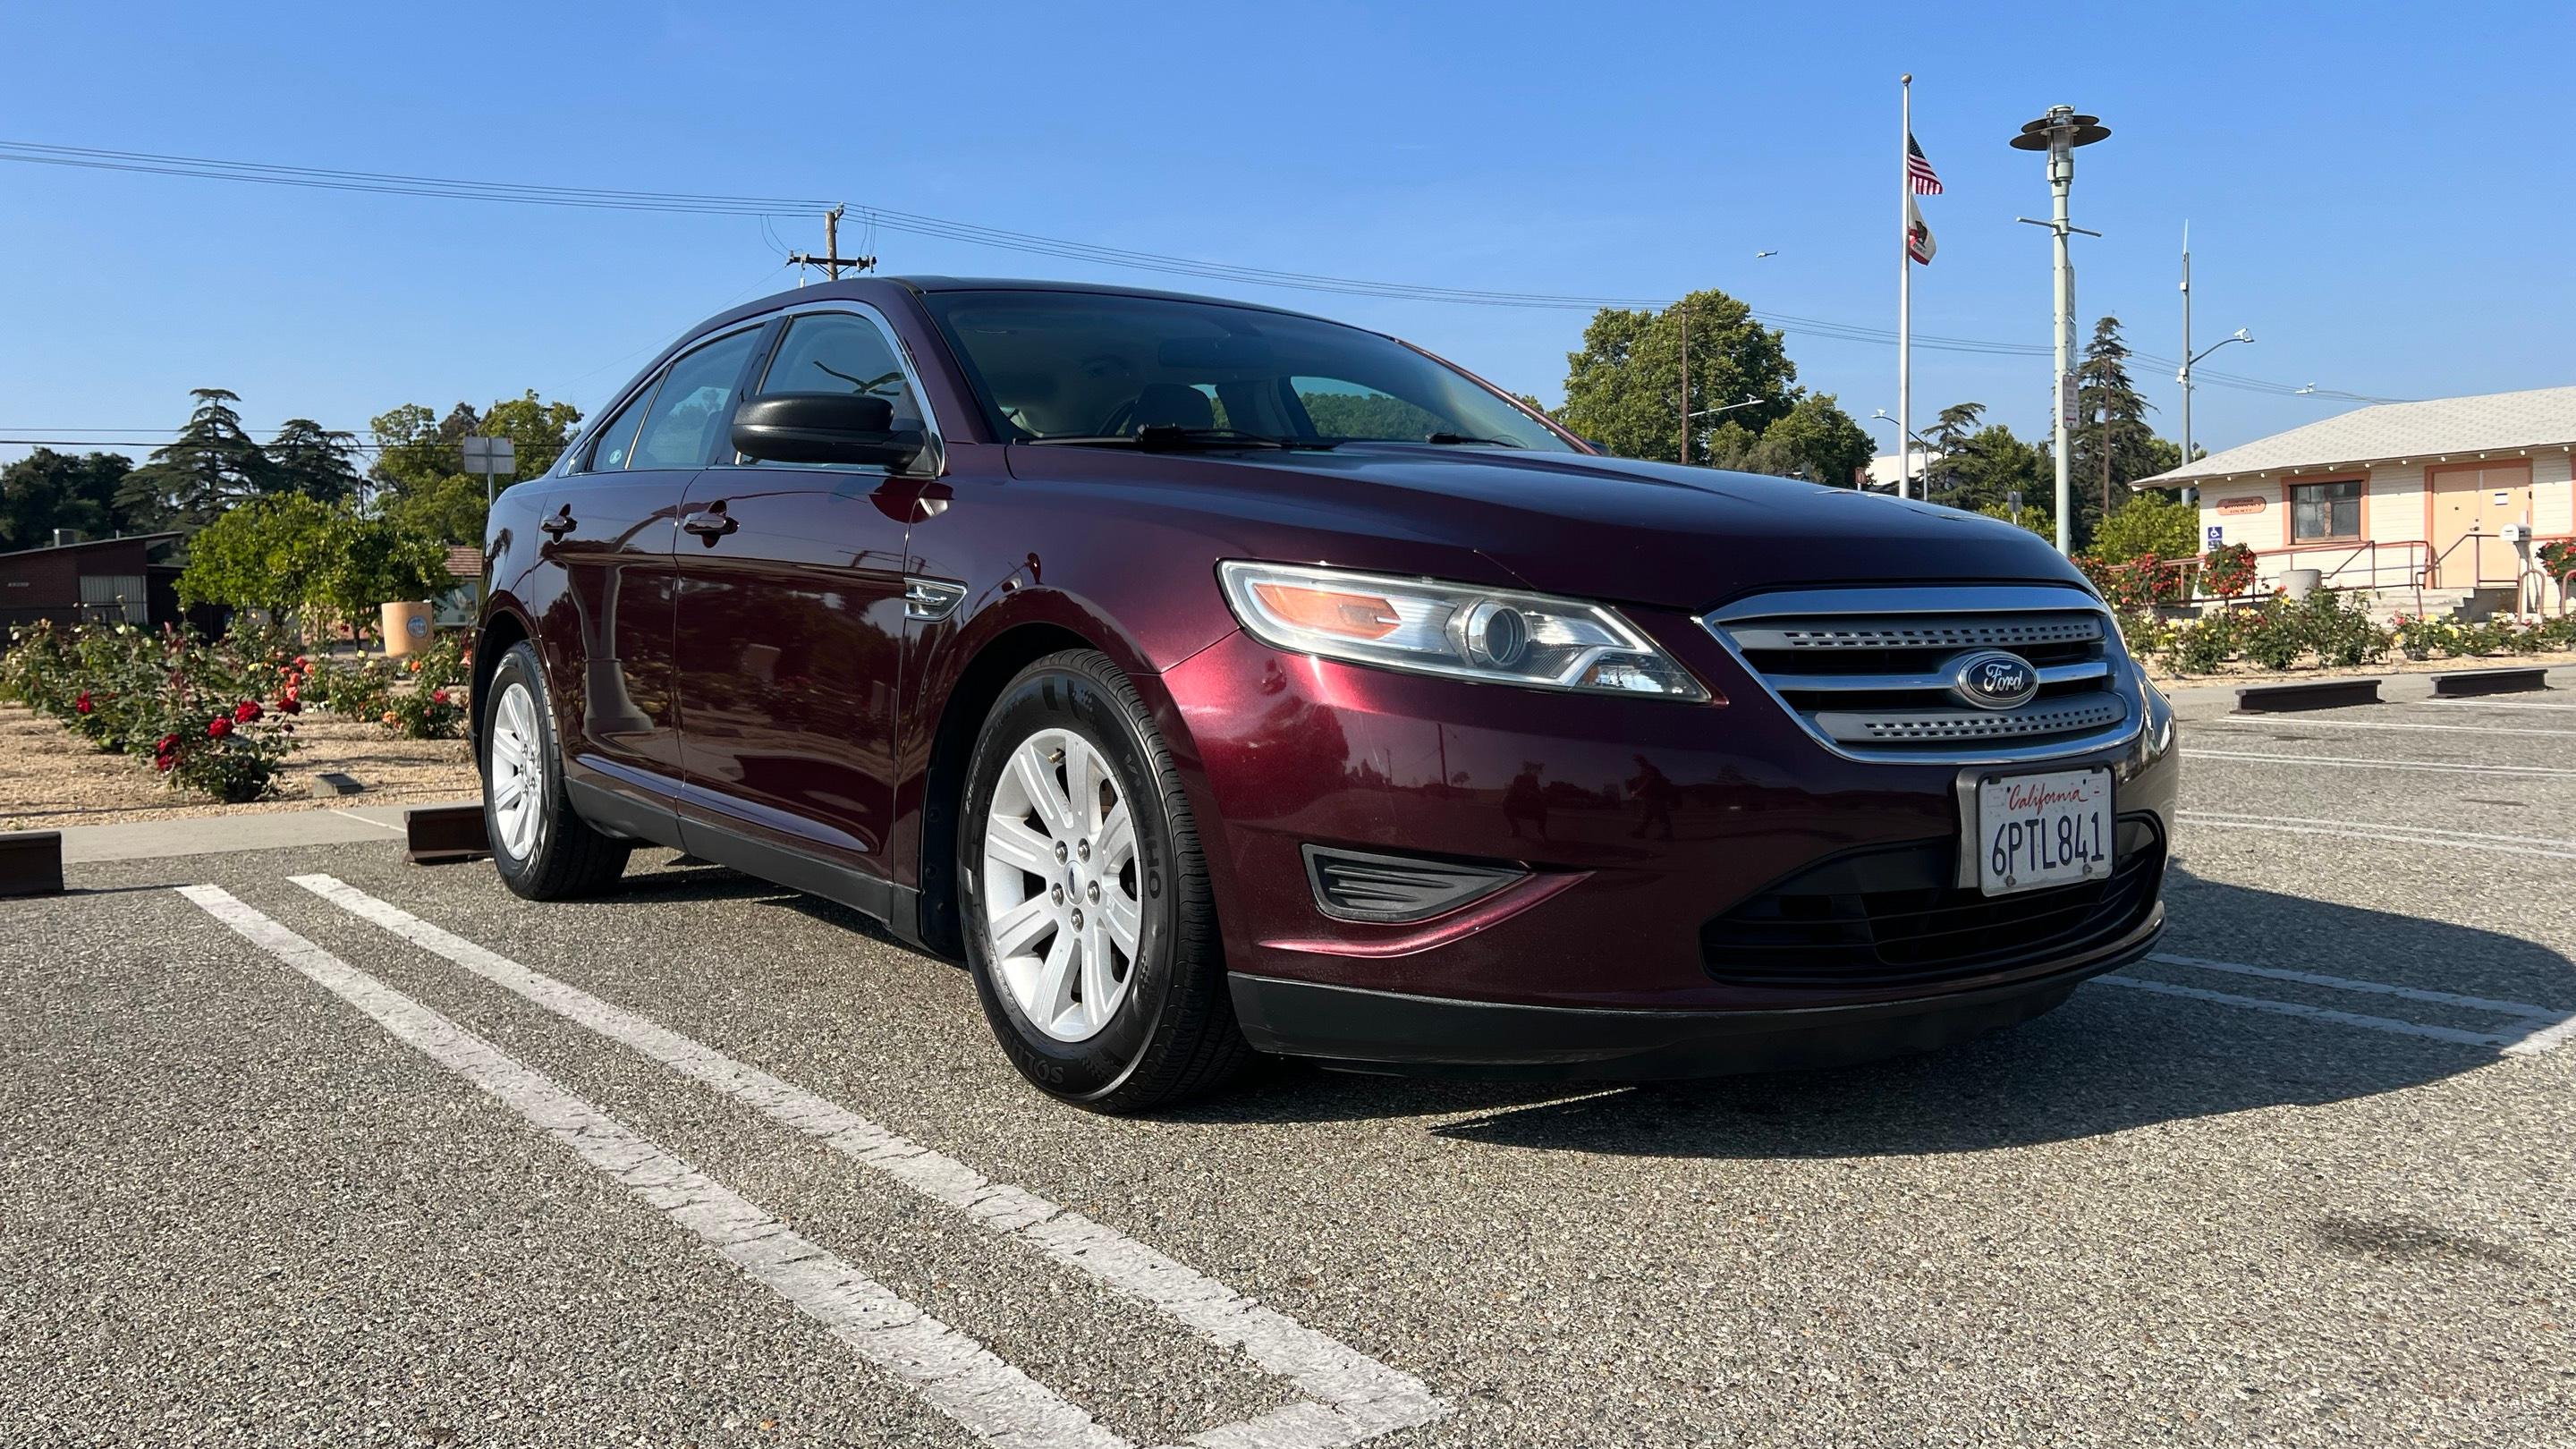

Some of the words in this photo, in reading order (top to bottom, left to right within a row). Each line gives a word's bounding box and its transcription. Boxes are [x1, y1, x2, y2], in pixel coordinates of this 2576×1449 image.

[1983, 664, 2024, 693] Ford
[2009, 783, 2089, 816] California
[1124, 753, 1162, 899] KHO
[1992, 811, 2105, 876] 6PTL841
